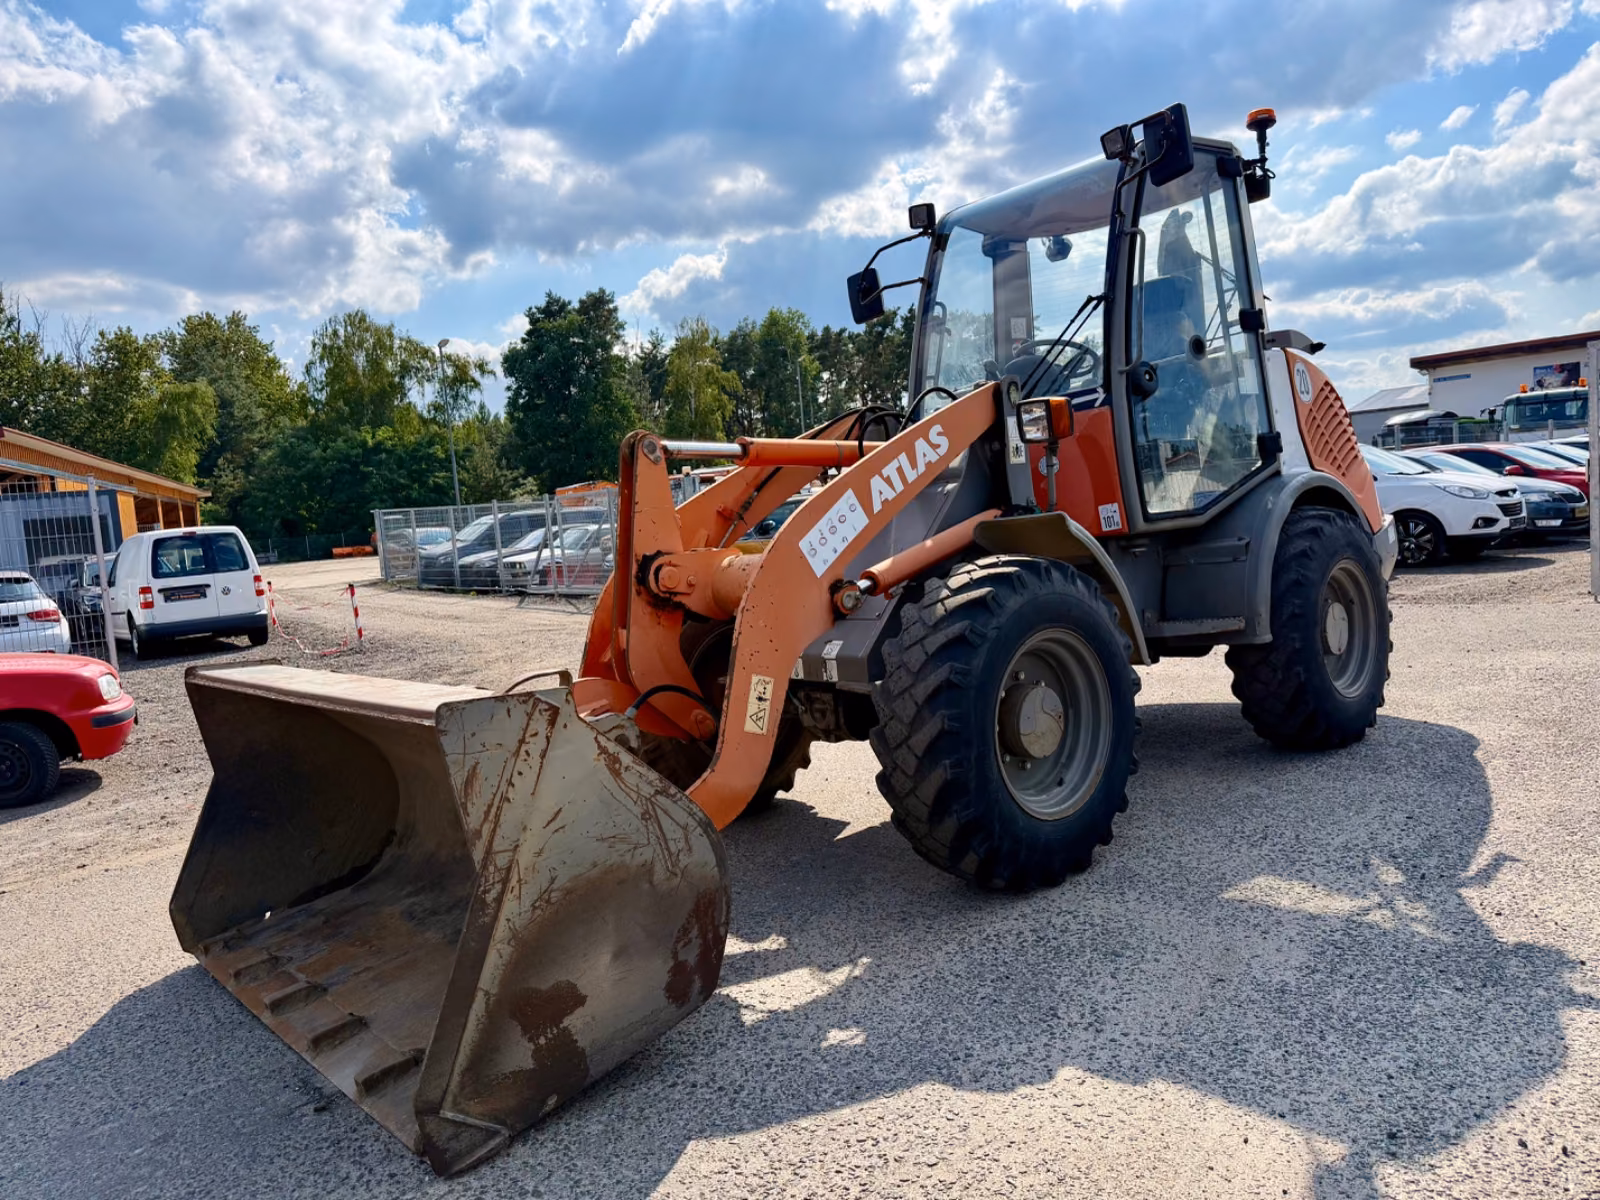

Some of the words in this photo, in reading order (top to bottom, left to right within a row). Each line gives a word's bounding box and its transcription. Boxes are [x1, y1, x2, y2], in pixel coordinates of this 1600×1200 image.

[1296, 368, 1310, 395] 20
[870, 424, 949, 514] ATLAS
[1102, 515, 1116, 529] 101
